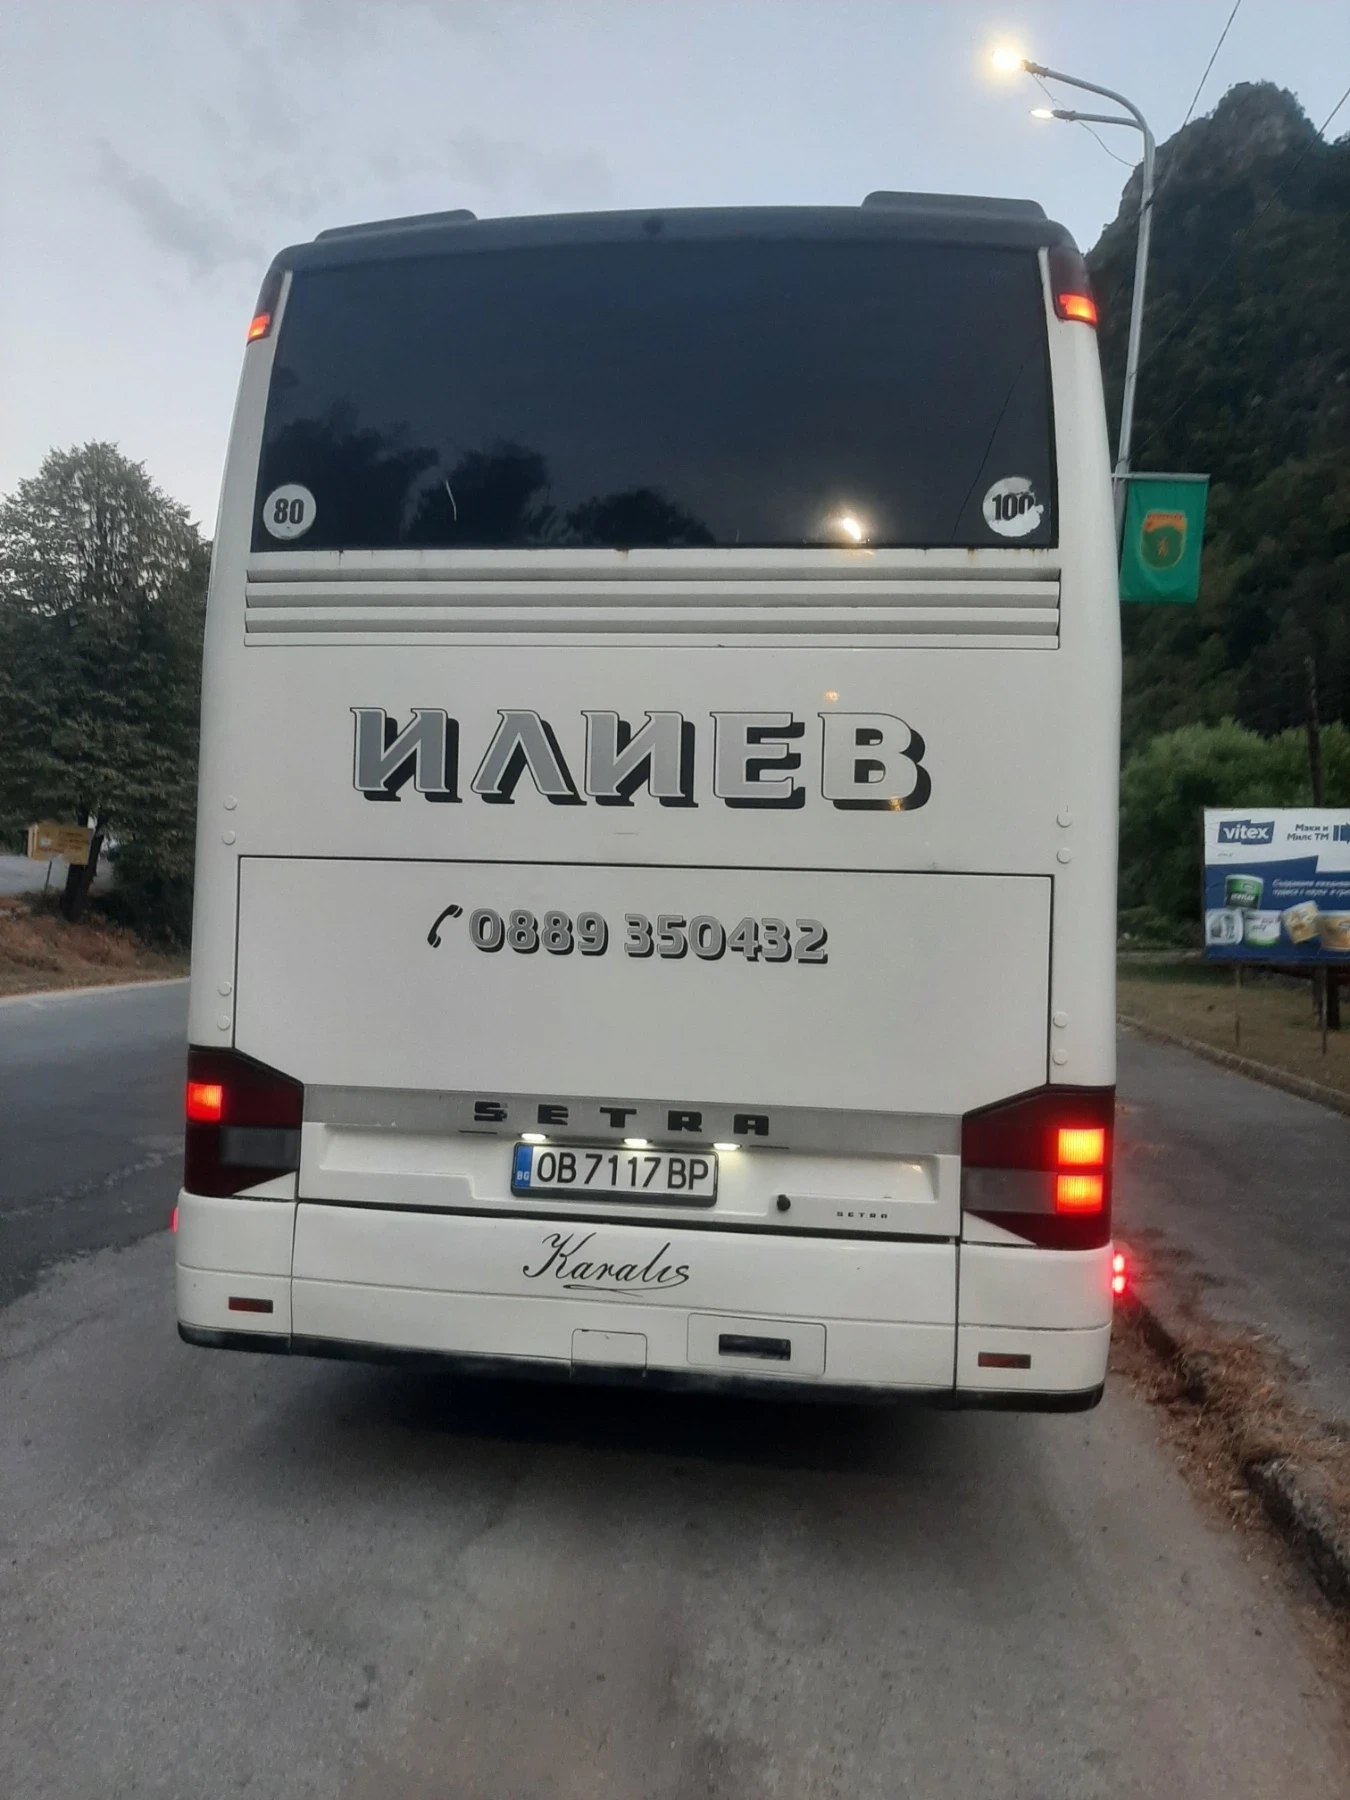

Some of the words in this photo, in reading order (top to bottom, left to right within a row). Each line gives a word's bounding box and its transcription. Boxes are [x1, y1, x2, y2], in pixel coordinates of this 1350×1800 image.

[273, 498, 305, 525] 80
[991, 493, 1035, 521] 100
[349, 707, 932, 811] ИЛИЕВ
[1223, 824, 1270, 840] vitex
[468, 908, 609, 956] 0889
[624, 913, 829, 965] 350432
[473, 1101, 770, 1137] SETRA
[516, 1170, 530, 1181] BG
[522, 1232, 690, 1297] Karalis
